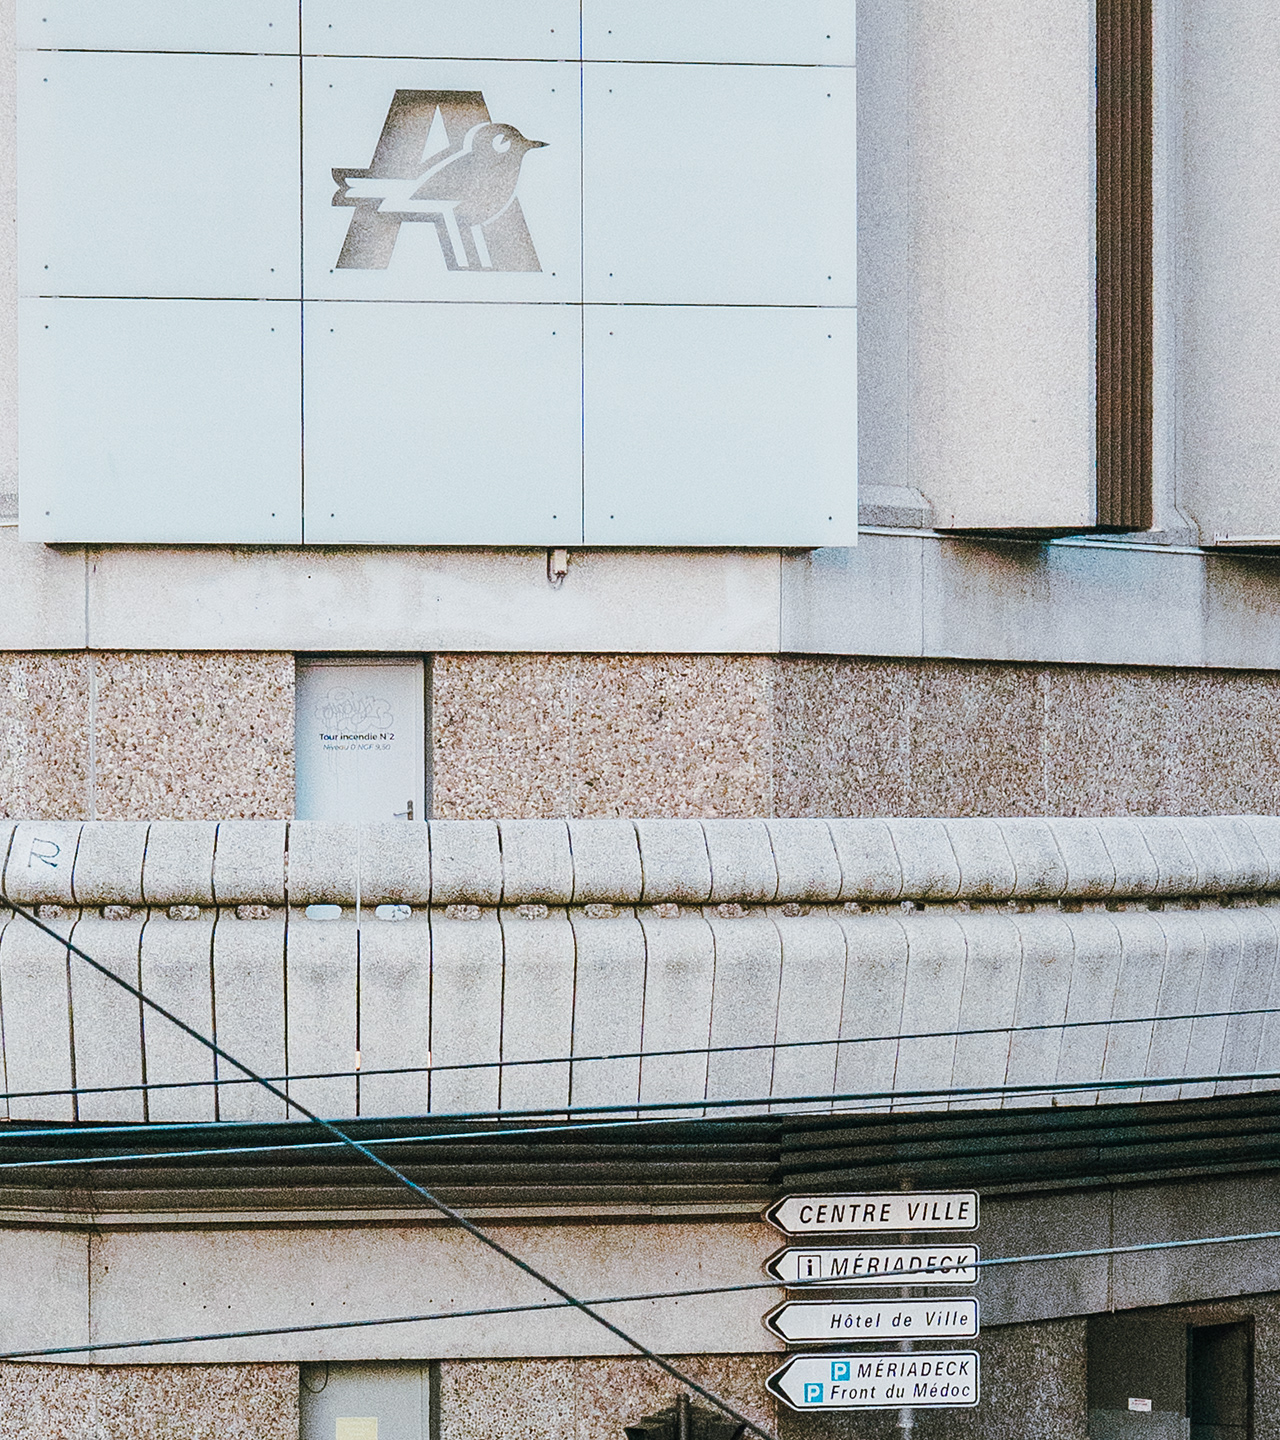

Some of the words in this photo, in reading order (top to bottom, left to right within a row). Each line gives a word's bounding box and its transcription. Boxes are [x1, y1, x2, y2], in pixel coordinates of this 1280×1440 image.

[319, 733, 338, 741] Tour
[340, 732, 378, 741] incendie
[799, 1203, 891, 1224] CENTRE
[907, 1201, 970, 1221] VILLE
[830, 1253, 969, 1276] MÉRIADECK
[830, 1313, 881, 1329] Hôtel
[891, 1312, 913, 1327] de
[925, 1311, 969, 1327] Ville
[857, 1359, 970, 1379] MÉRIADECK
[830, 1385, 876, 1400] Front
[885, 1384, 905, 1399] du
[913, 1382, 971, 1398] Médoc
